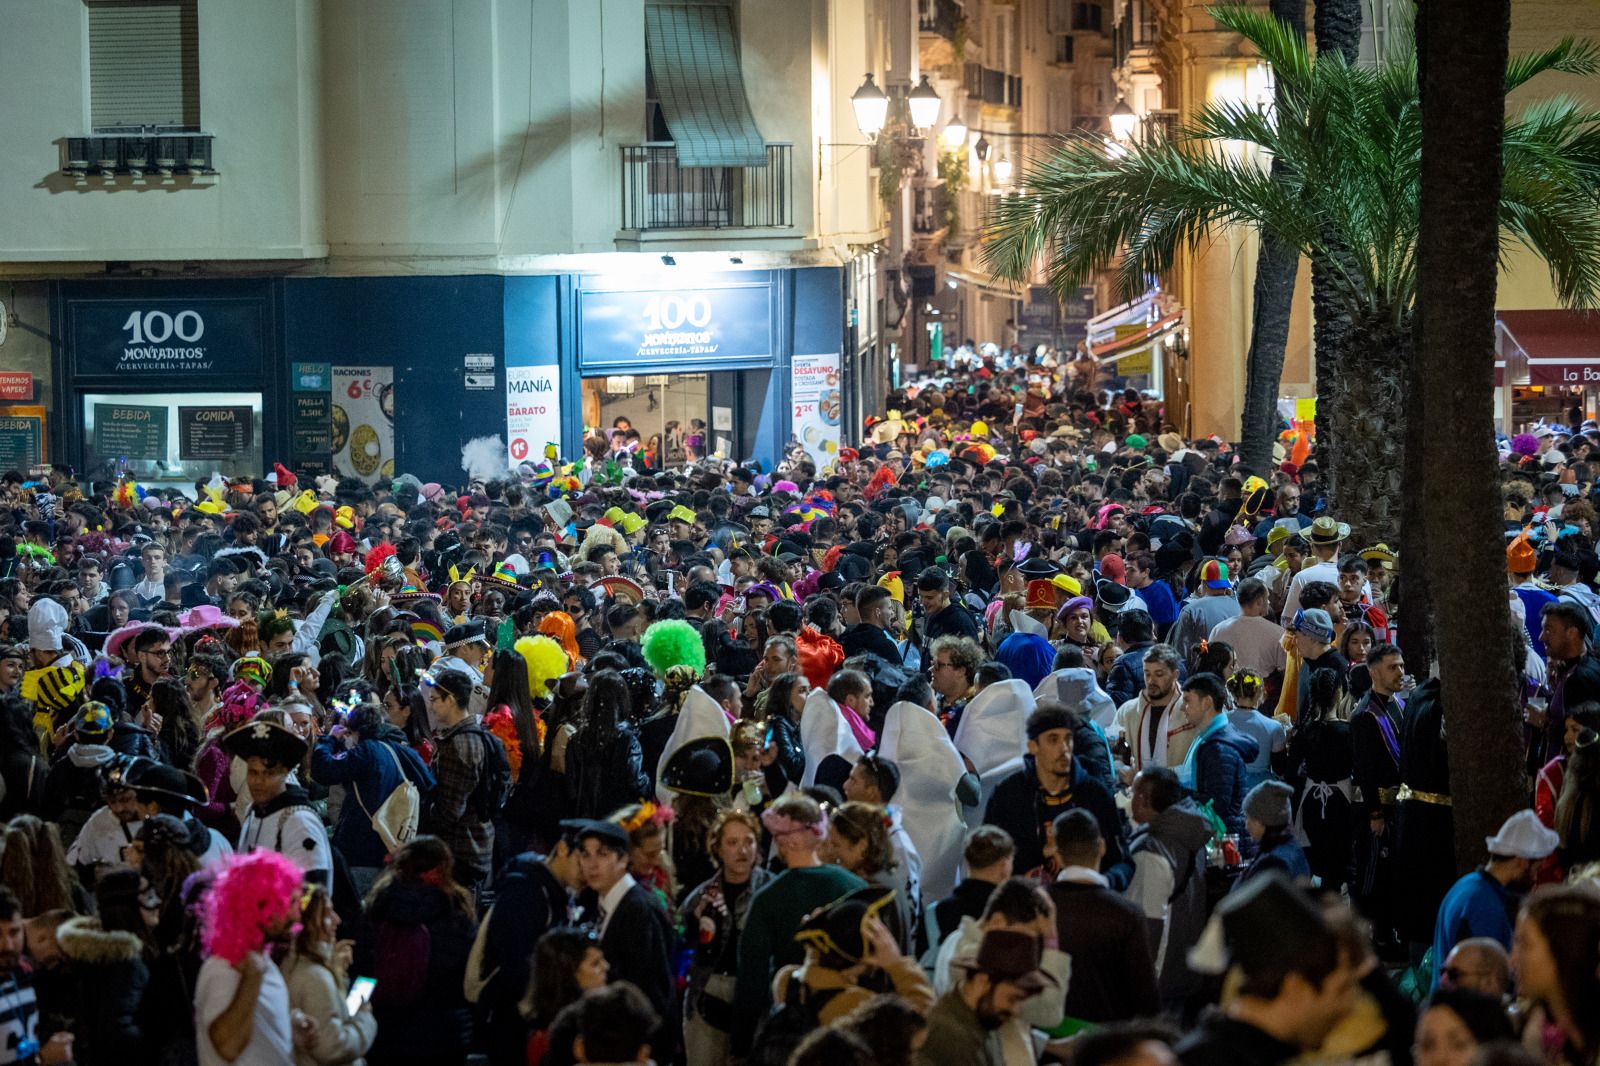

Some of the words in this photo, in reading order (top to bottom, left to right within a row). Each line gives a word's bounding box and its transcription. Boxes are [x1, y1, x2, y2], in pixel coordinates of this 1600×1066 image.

[642, 295, 712, 331] 100
[122, 310, 205, 344] 100
[121, 346, 204, 361] MONTADITOS
[334, 369, 372, 377] RACIONES
[794, 366, 834, 375] DESAYUNO
[1564, 368, 1578, 381] La
[508, 376, 552, 394] MANÍA
[112, 409, 151, 422] BEBIDA
[196, 411, 234, 422] COMIDA
[509, 406, 546, 416] BARATO
